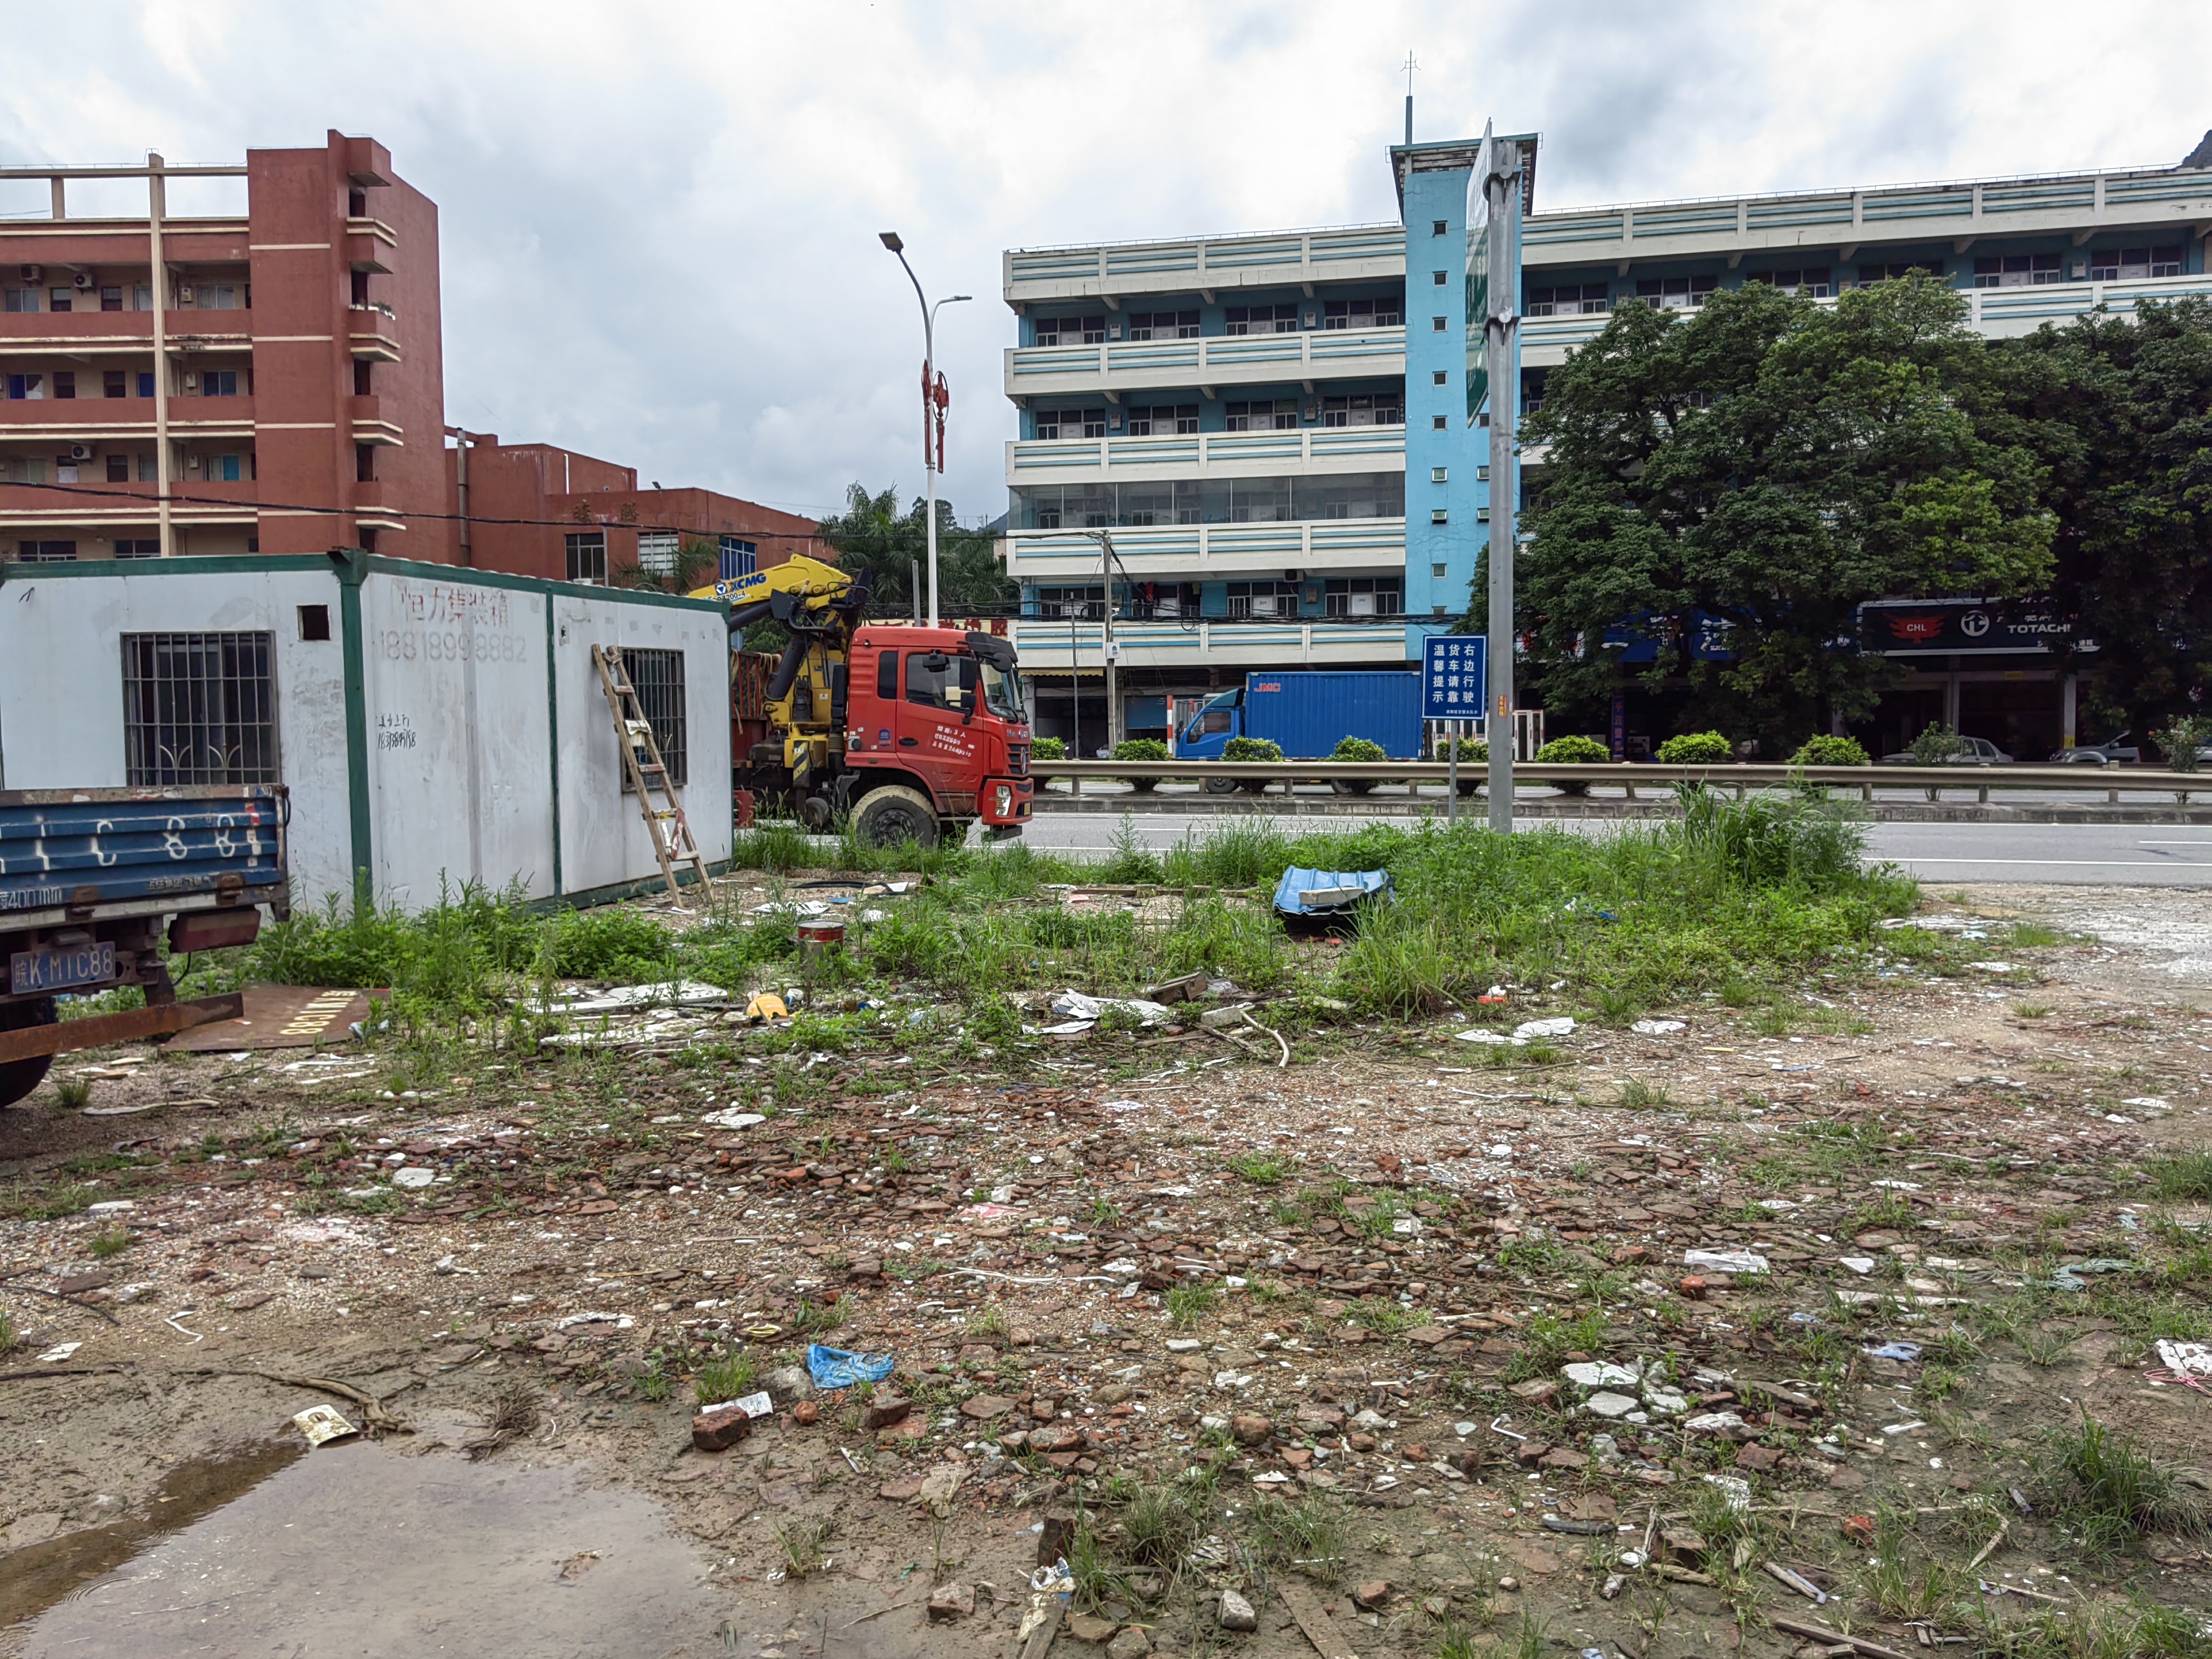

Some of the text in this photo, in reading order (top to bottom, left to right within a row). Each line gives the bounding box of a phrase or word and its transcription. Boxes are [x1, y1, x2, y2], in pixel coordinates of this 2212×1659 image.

[729, 573, 767, 592] XCMG
[1254, 683, 1281, 692] JMC
[1433, 644, 1445, 703] 温馨提示
[1447, 644, 1460, 703] 货车请靠
[1462, 644, 1475, 703] 右边行驶
